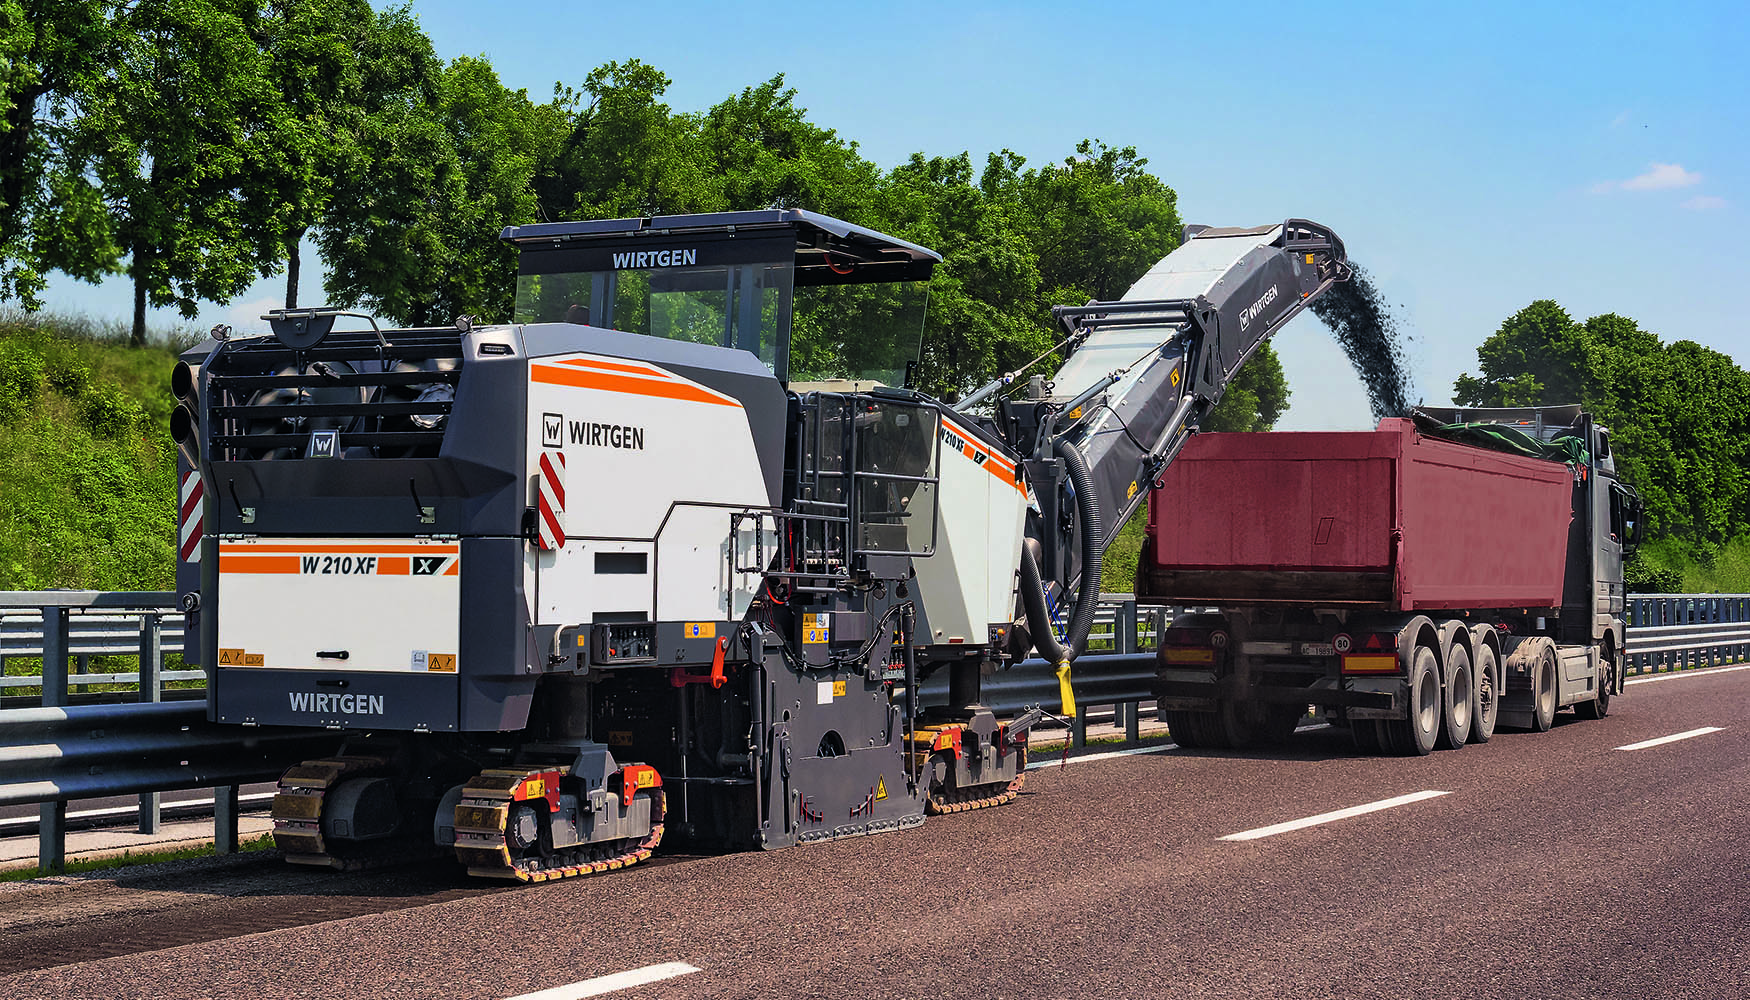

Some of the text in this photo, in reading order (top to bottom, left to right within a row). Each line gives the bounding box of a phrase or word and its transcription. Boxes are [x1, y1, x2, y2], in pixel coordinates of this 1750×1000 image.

[613, 249, 697, 269] WIRTGEN
[1248, 283, 1278, 319] WIRTGEN
[569, 420, 644, 450] WIRTGEN
[945, 431, 957, 448] 210
[302, 556, 433, 575] W 210 XF X
[1214, 635, 1224, 645] 70
[1337, 639, 1348, 649] 80
[289, 692, 384, 715] WIRTGEN
